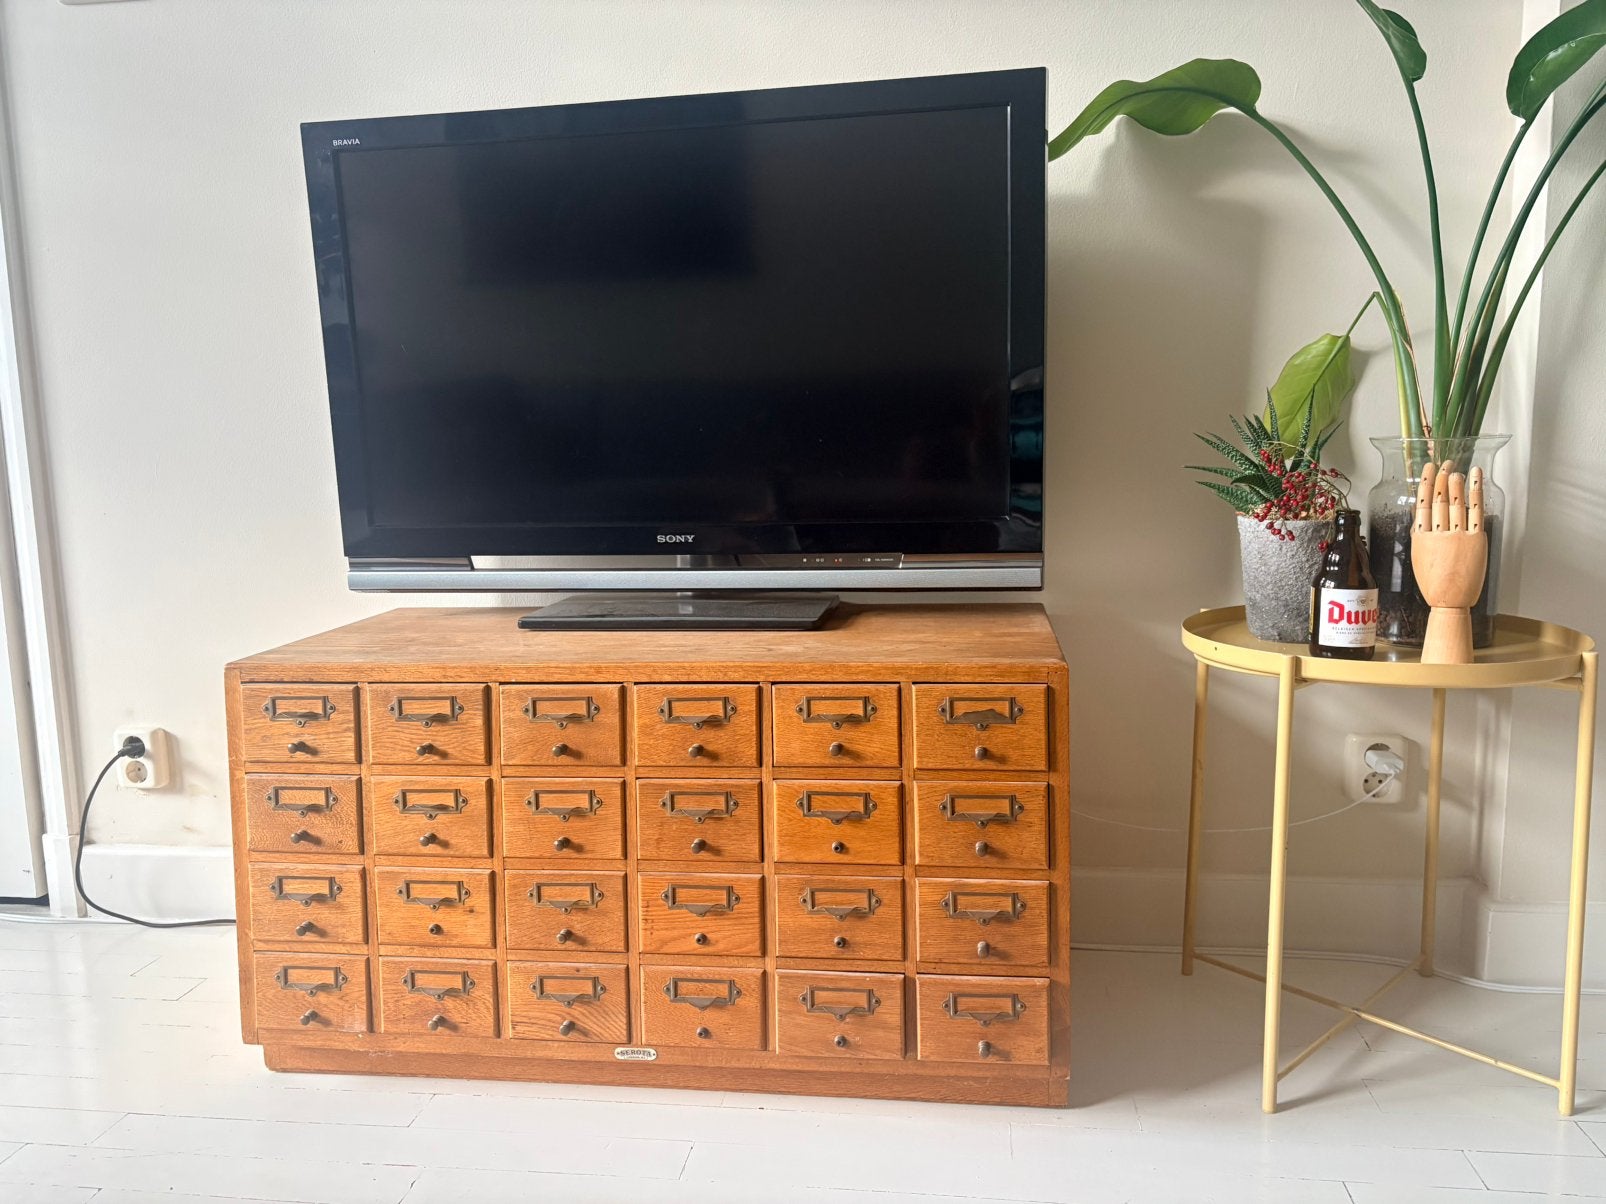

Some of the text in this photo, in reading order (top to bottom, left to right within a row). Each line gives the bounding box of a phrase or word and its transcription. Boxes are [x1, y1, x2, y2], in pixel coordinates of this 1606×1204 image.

[332, 138, 361, 147] BRAVIA
[656, 534, 696, 543] SONY
[619, 1049, 652, 1057] SEROTA
